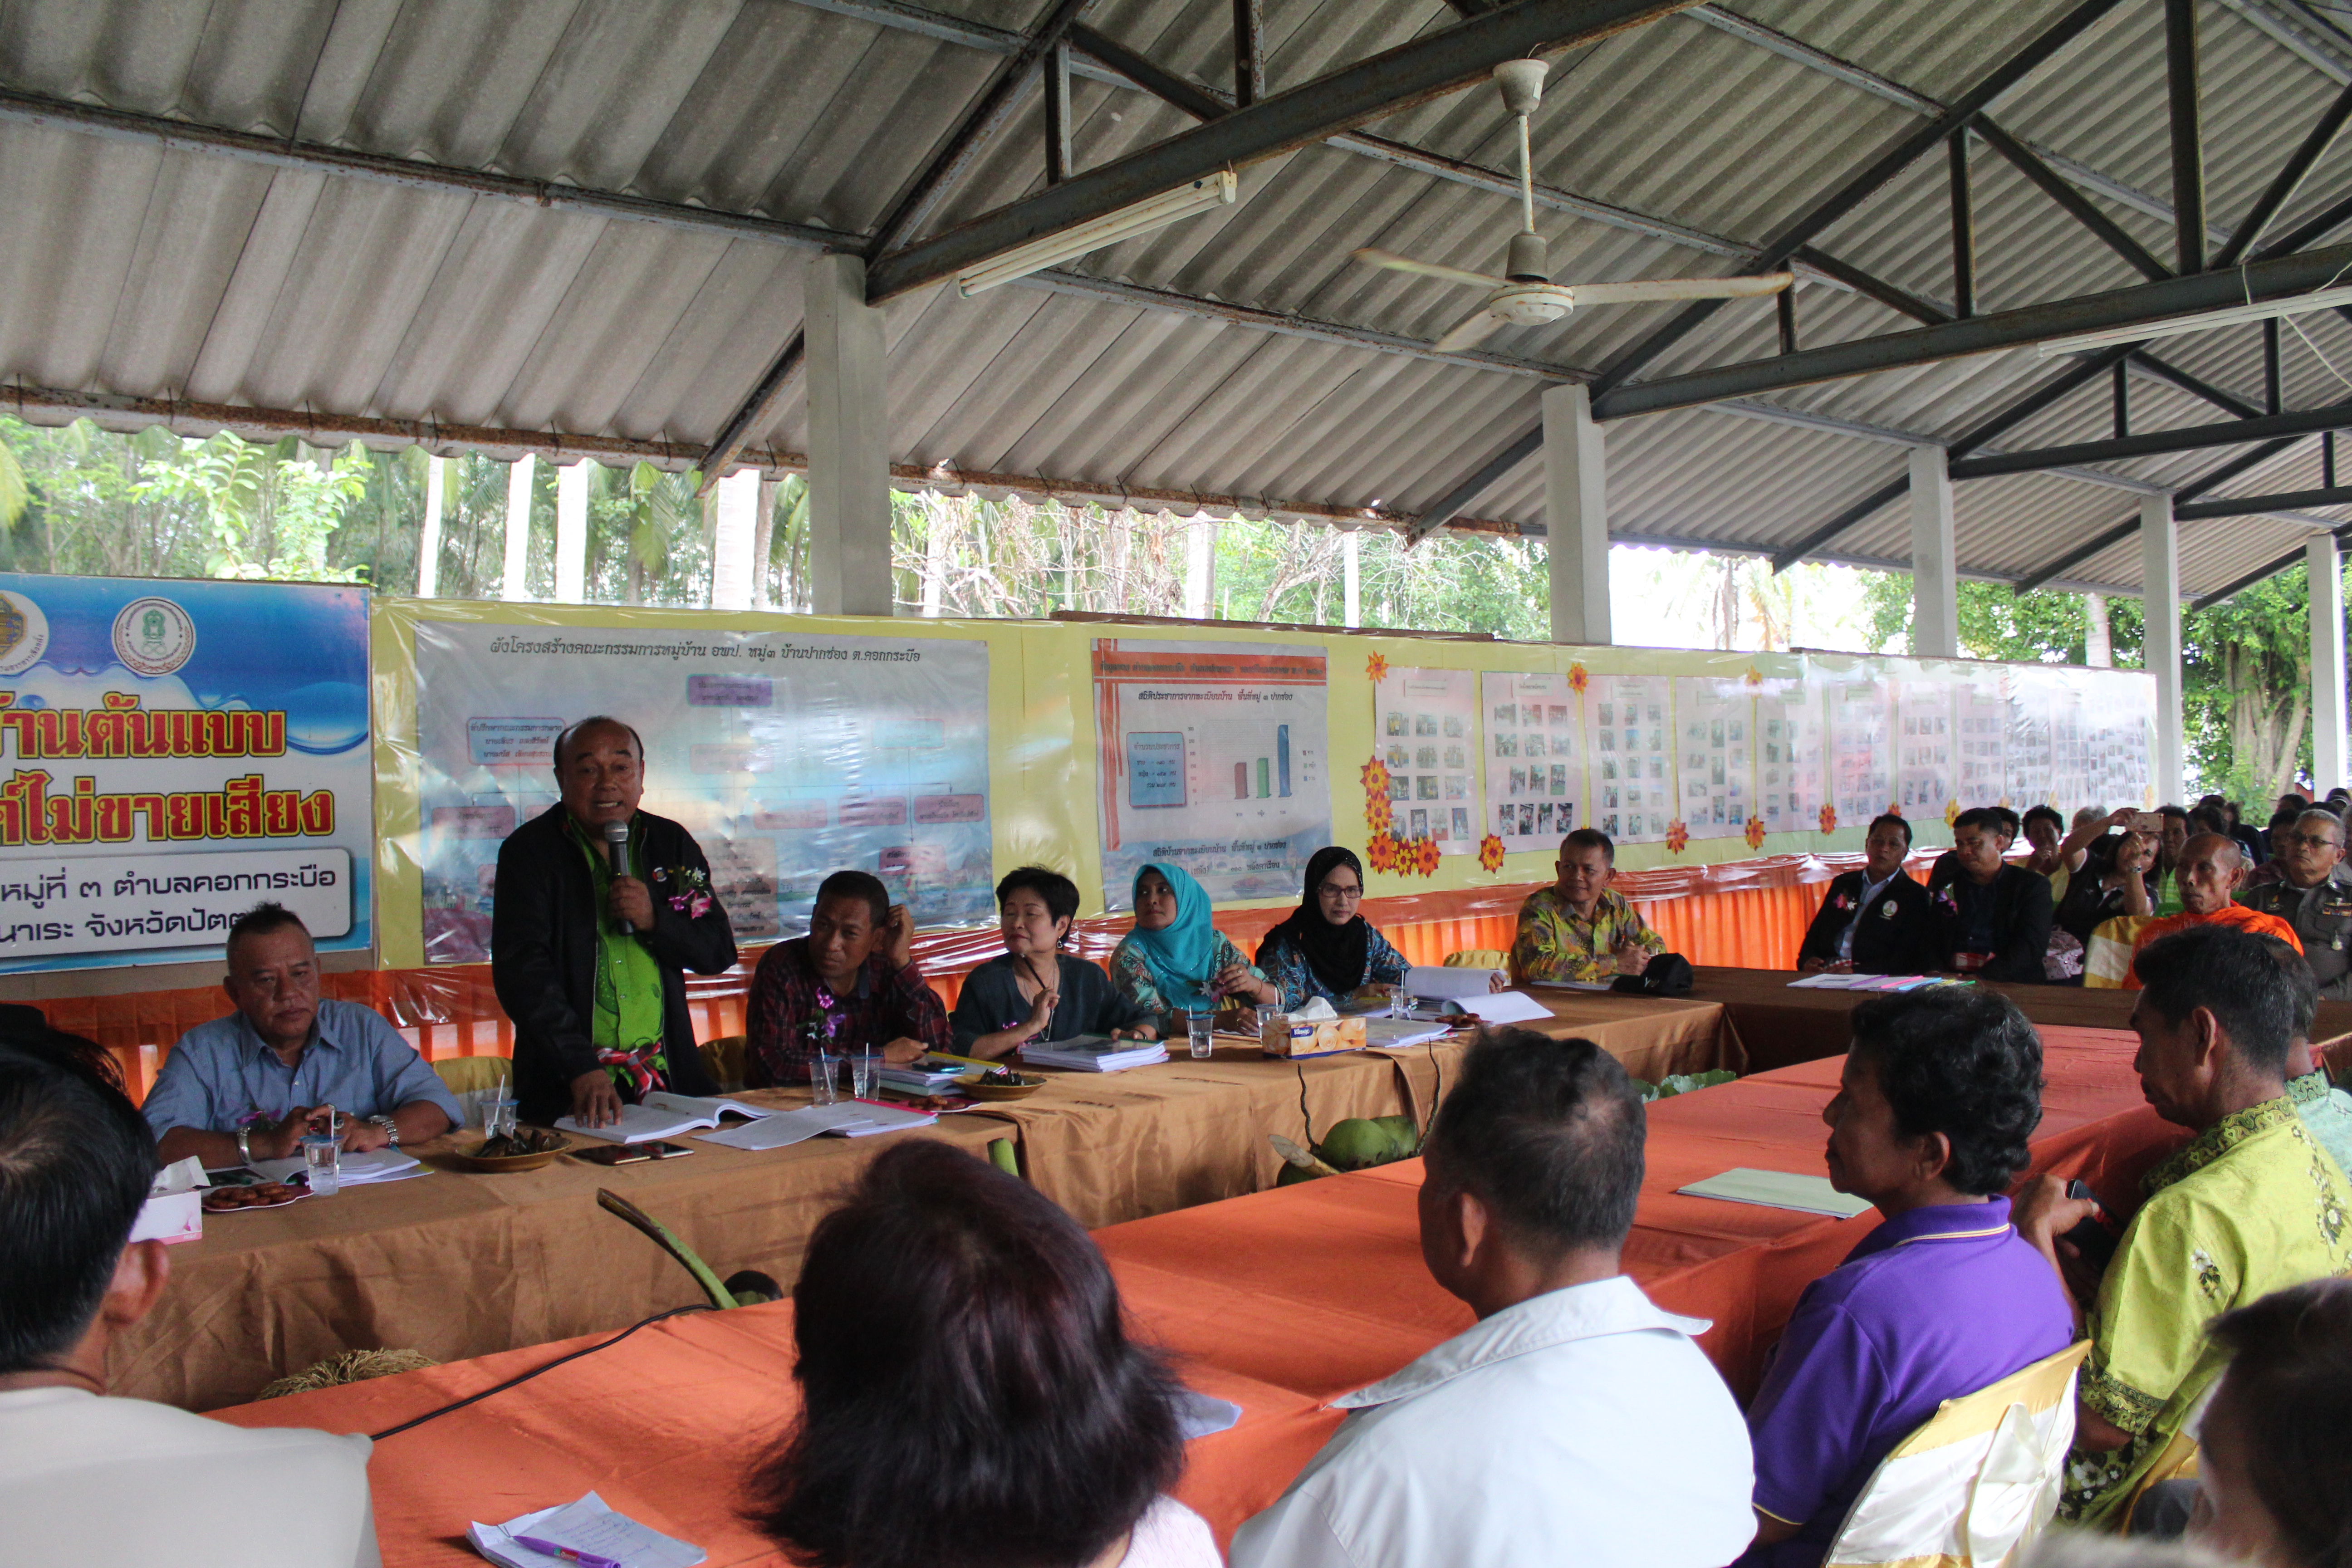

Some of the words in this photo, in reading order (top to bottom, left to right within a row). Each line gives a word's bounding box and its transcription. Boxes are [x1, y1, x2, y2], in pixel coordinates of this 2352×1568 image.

[490, 635, 707, 661] ผังโครงสร้างคณะกรรมการหมู่บ้าน
[0, 691, 287, 759] านต้นแบบ
[1, 867, 66, 909] หมู่ที่
[80, 882, 101, 897] ๓
[114, 864, 336, 896] ตำบลคอกกระบือ
